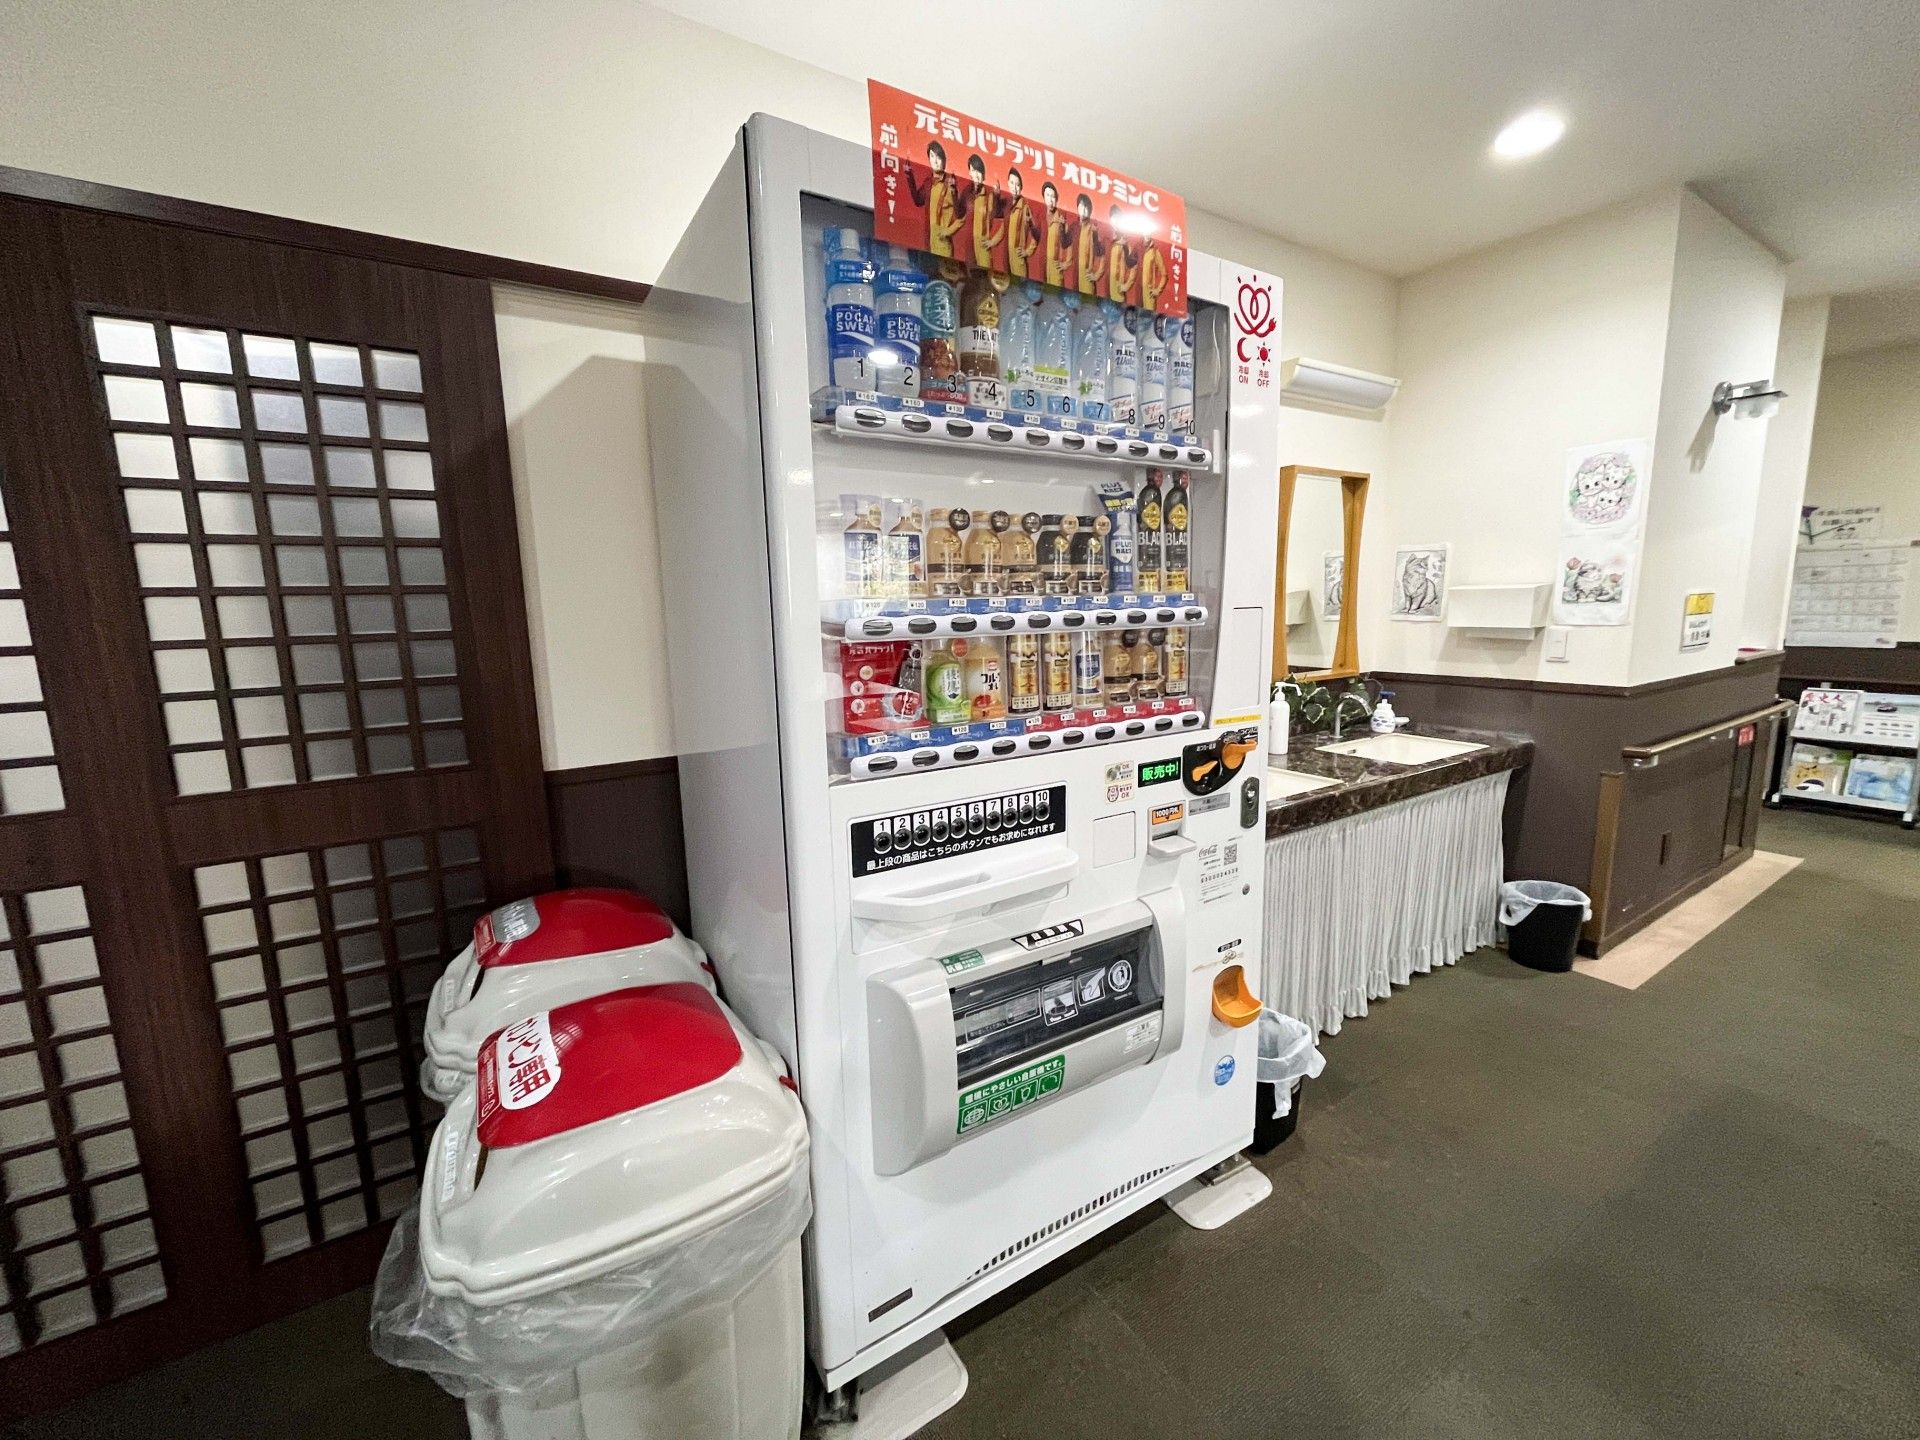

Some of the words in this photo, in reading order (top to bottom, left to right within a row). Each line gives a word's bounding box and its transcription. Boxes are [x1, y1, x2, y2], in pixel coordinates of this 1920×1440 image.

[1061, 161, 1160, 213] オロナミンC
[857, 358, 863, 377] 1
[904, 367, 913, 386] 2
[948, 375, 956, 393] 3
[1238, 374, 1249, 384] ON
[1257, 378, 1270, 388] OFF
[988, 383, 997, 400] 4
[1026, 390, 1035, 407] 5
[1062, 396, 1070, 413] 6
[1097, 403, 1103, 418] 7
[1129, 409, 1135, 424] 8
[1159, 414, 1164, 430] 9
[1185, 420, 1195, 435] 10
[1142, 761, 1179, 781] 販売中!
[1007, 798, 1014, 807] 8
[1024, 795, 1030, 804] 9
[1037, 792, 1048, 801] 10
[955, 808, 962, 817] 5
[973, 804, 980, 814] 6
[991, 801, 997, 810] 7
[899, 818, 906, 827] 2
[918, 815, 925, 825] 3
[937, 811, 944, 820] 4
[879, 822, 885, 831] 1
[866, 822, 1056, 871] 最上段の商品はこちらのボタンでもお求めになれます
